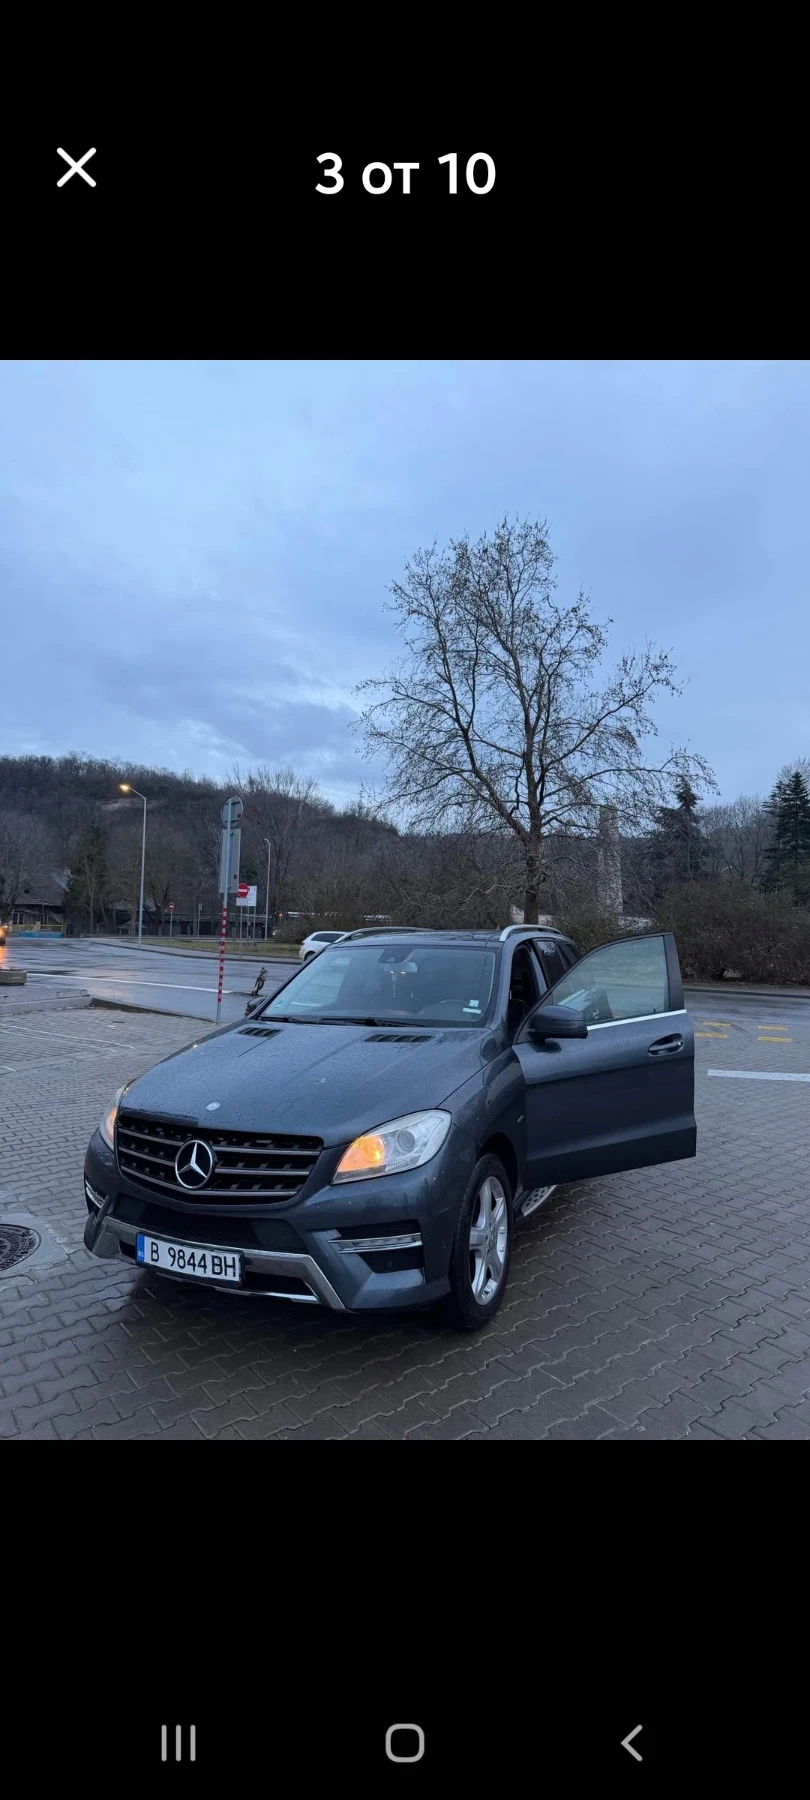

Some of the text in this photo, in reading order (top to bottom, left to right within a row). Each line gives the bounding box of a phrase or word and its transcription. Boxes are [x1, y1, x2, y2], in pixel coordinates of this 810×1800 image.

[151, 1241, 160, 1263] B
[167, 1246, 208, 1274] 9844
[211, 1254, 237, 1278] BH
